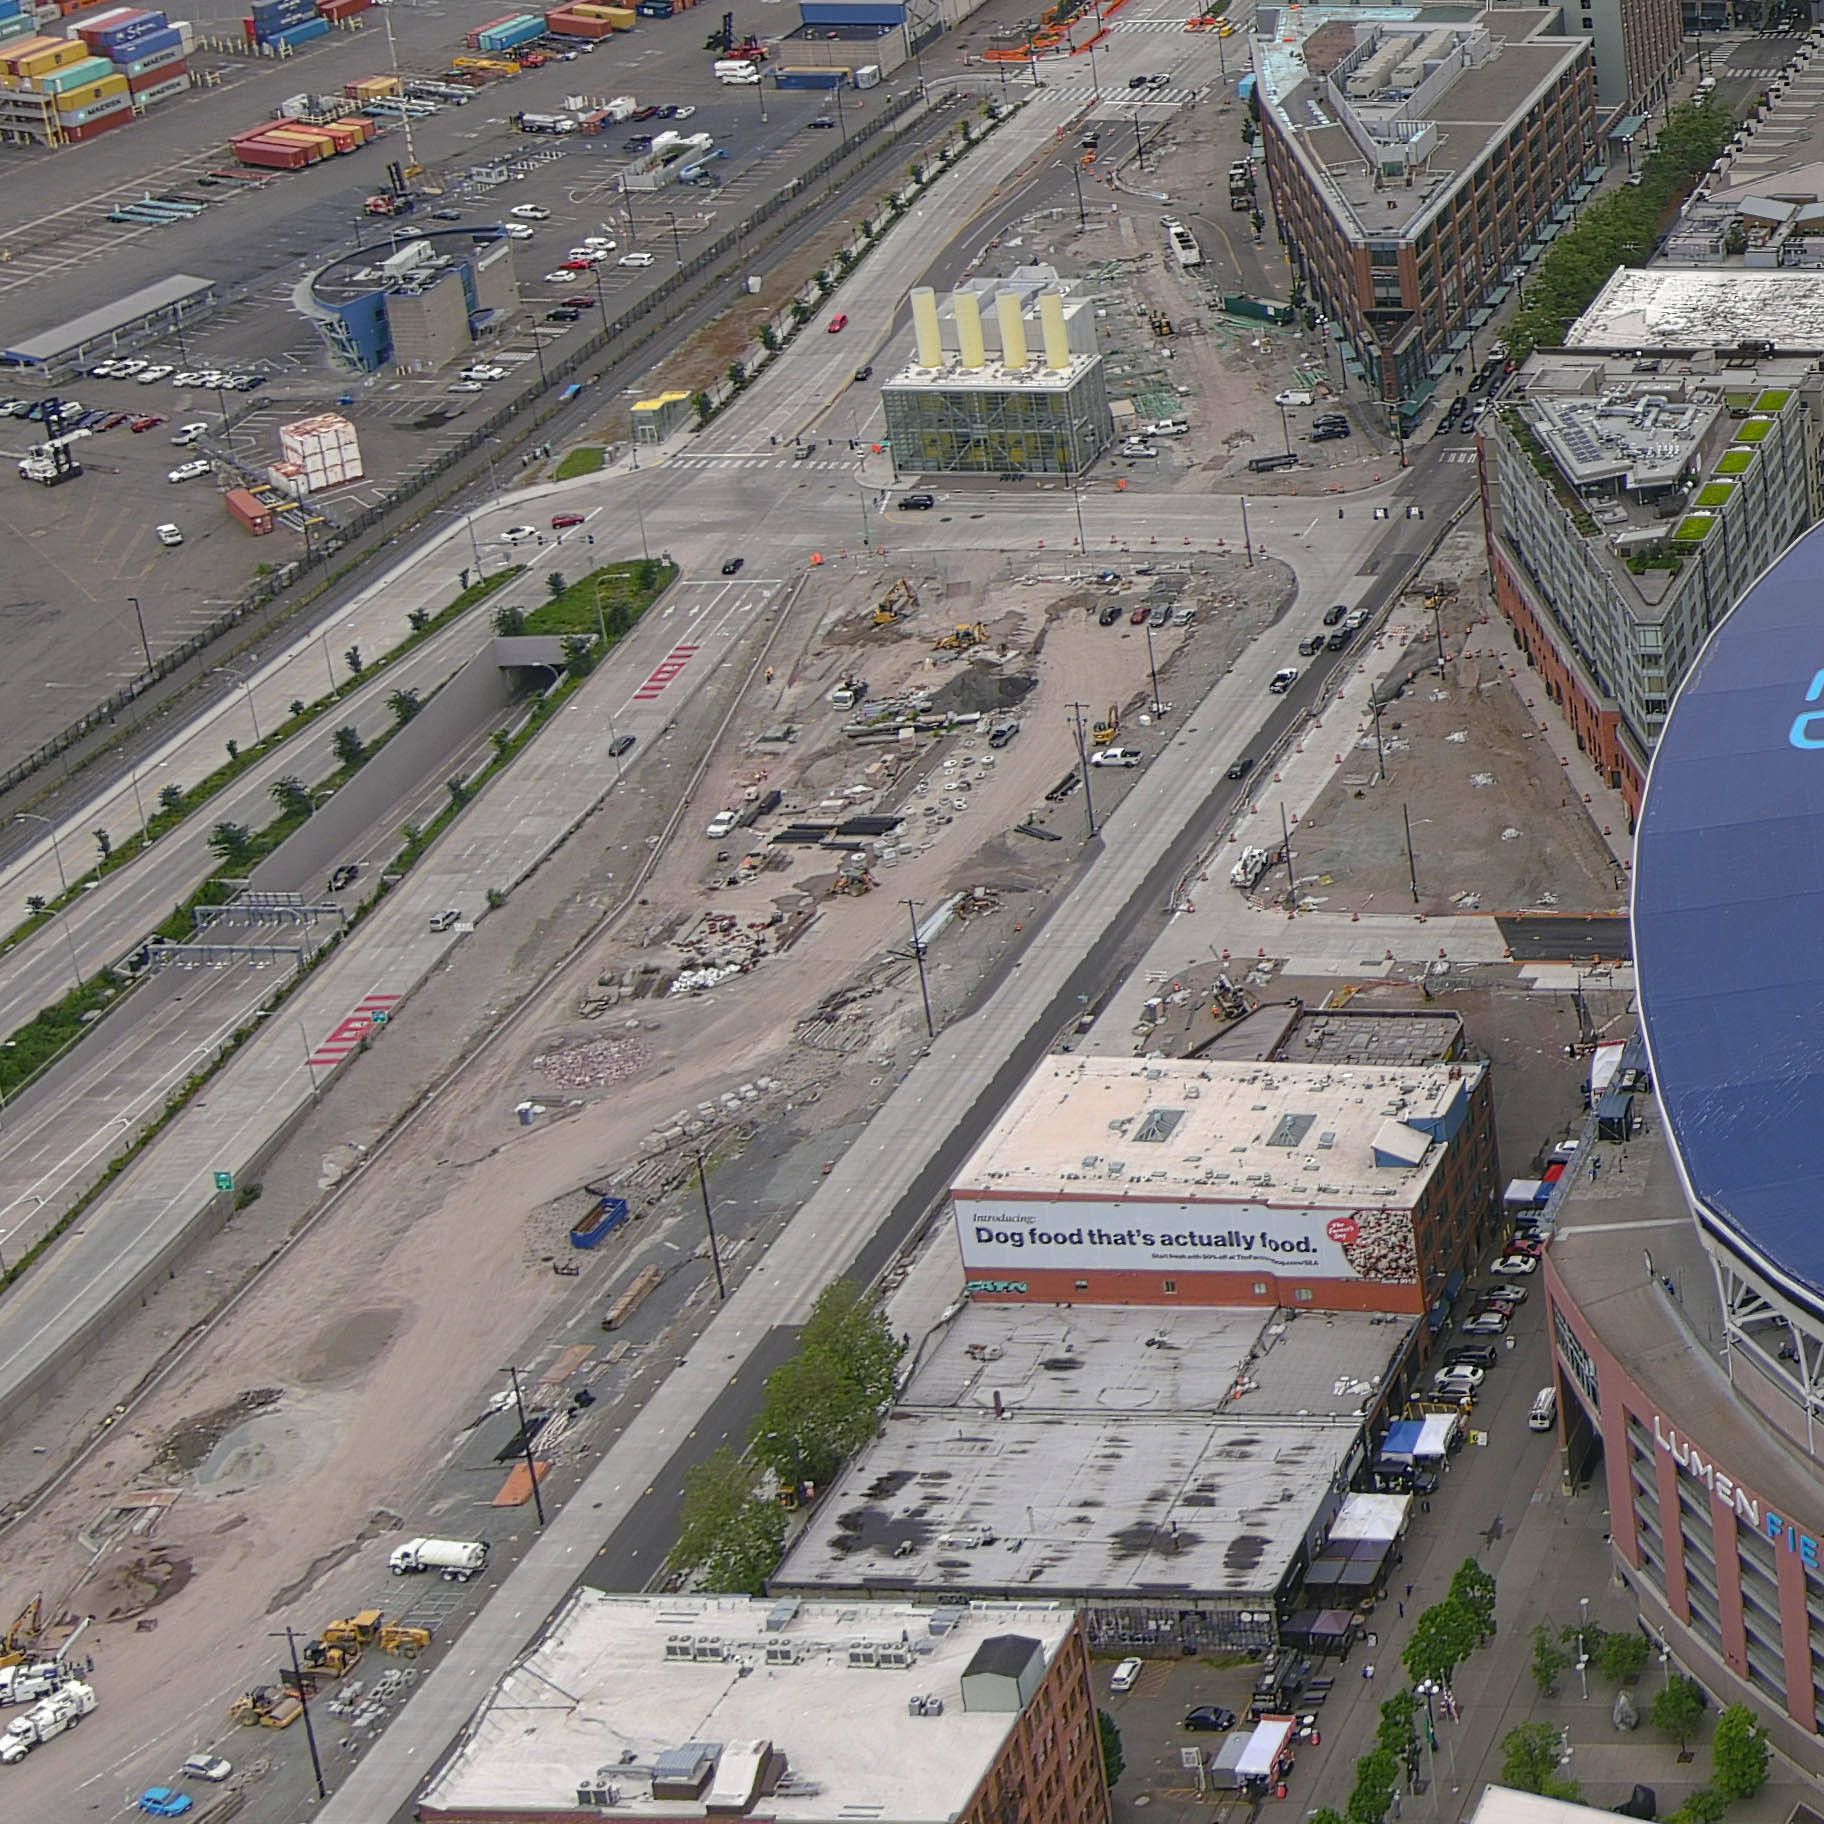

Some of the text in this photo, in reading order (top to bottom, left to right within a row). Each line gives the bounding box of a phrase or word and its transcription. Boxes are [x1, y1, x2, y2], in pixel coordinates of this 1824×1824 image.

[973, 1213, 1036, 1225] Introducing:
[976, 1227, 1318, 1254] Dog food that's actually food.
[1653, 1415, 1760, 1527] LUMEN
